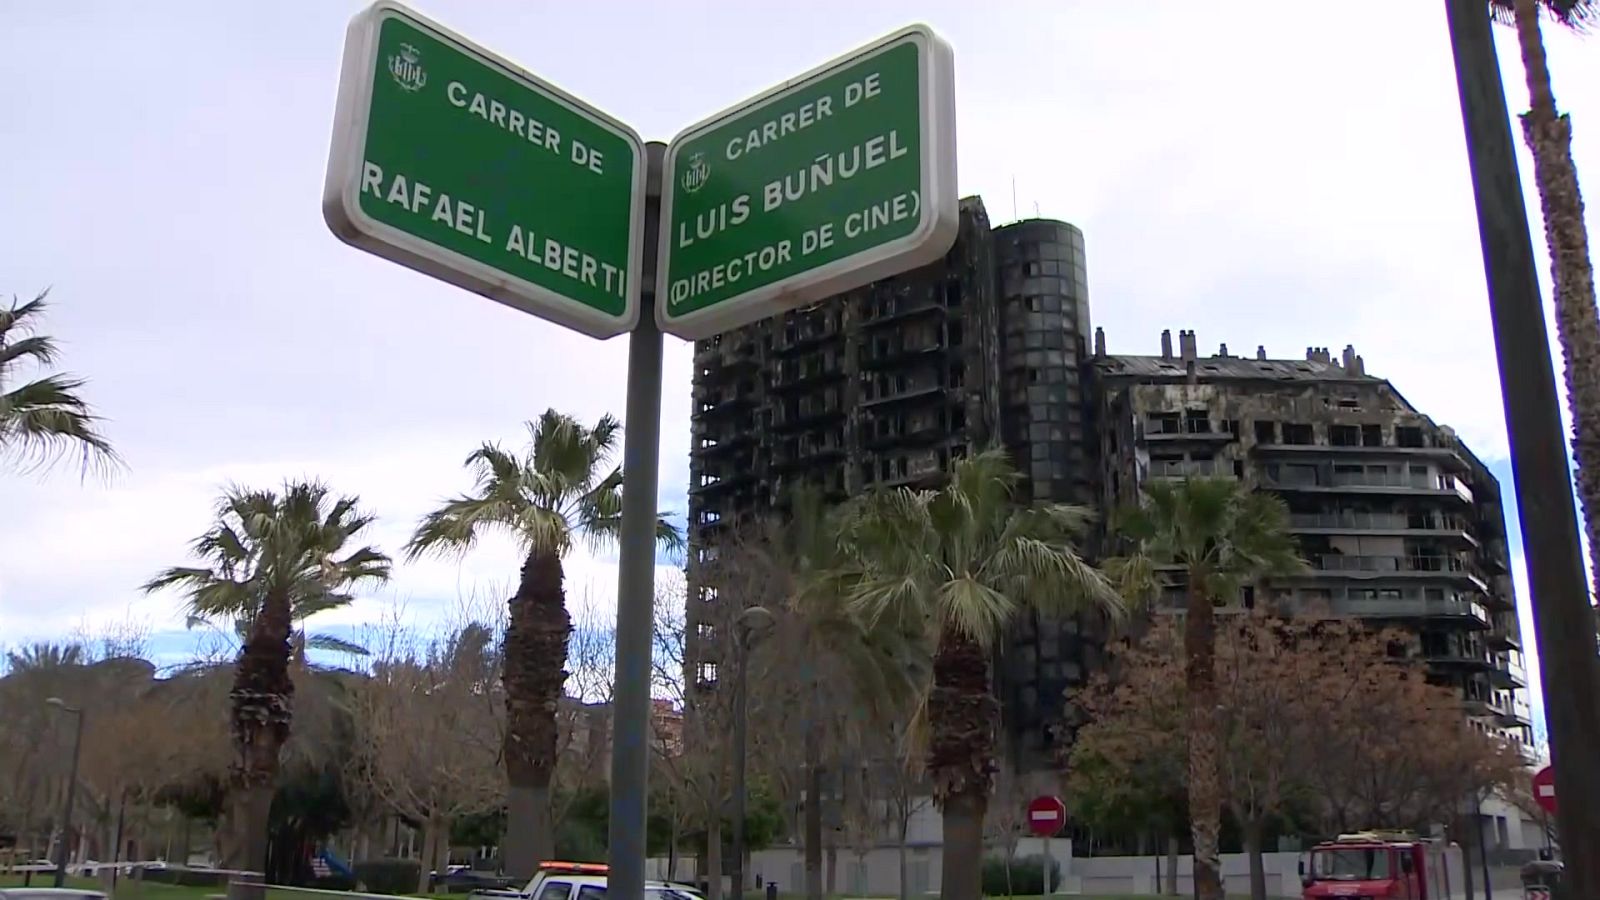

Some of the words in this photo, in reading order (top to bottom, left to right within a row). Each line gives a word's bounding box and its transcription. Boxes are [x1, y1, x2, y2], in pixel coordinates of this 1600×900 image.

[447, 81, 560, 154] CARRER
[571, 140, 603, 174] DE
[726, 96, 832, 160] CARRER
[844, 73, 881, 107] DE
[361, 160, 492, 243] RAFAEL
[505, 224, 624, 297] ALBERTI
[679, 194, 750, 248] LUIS
[763, 130, 908, 213] BUÑUEL
[670, 239, 792, 306] (DIRECTOR
[802, 223, 834, 255] DE
[844, 190, 921, 238] CINE)
